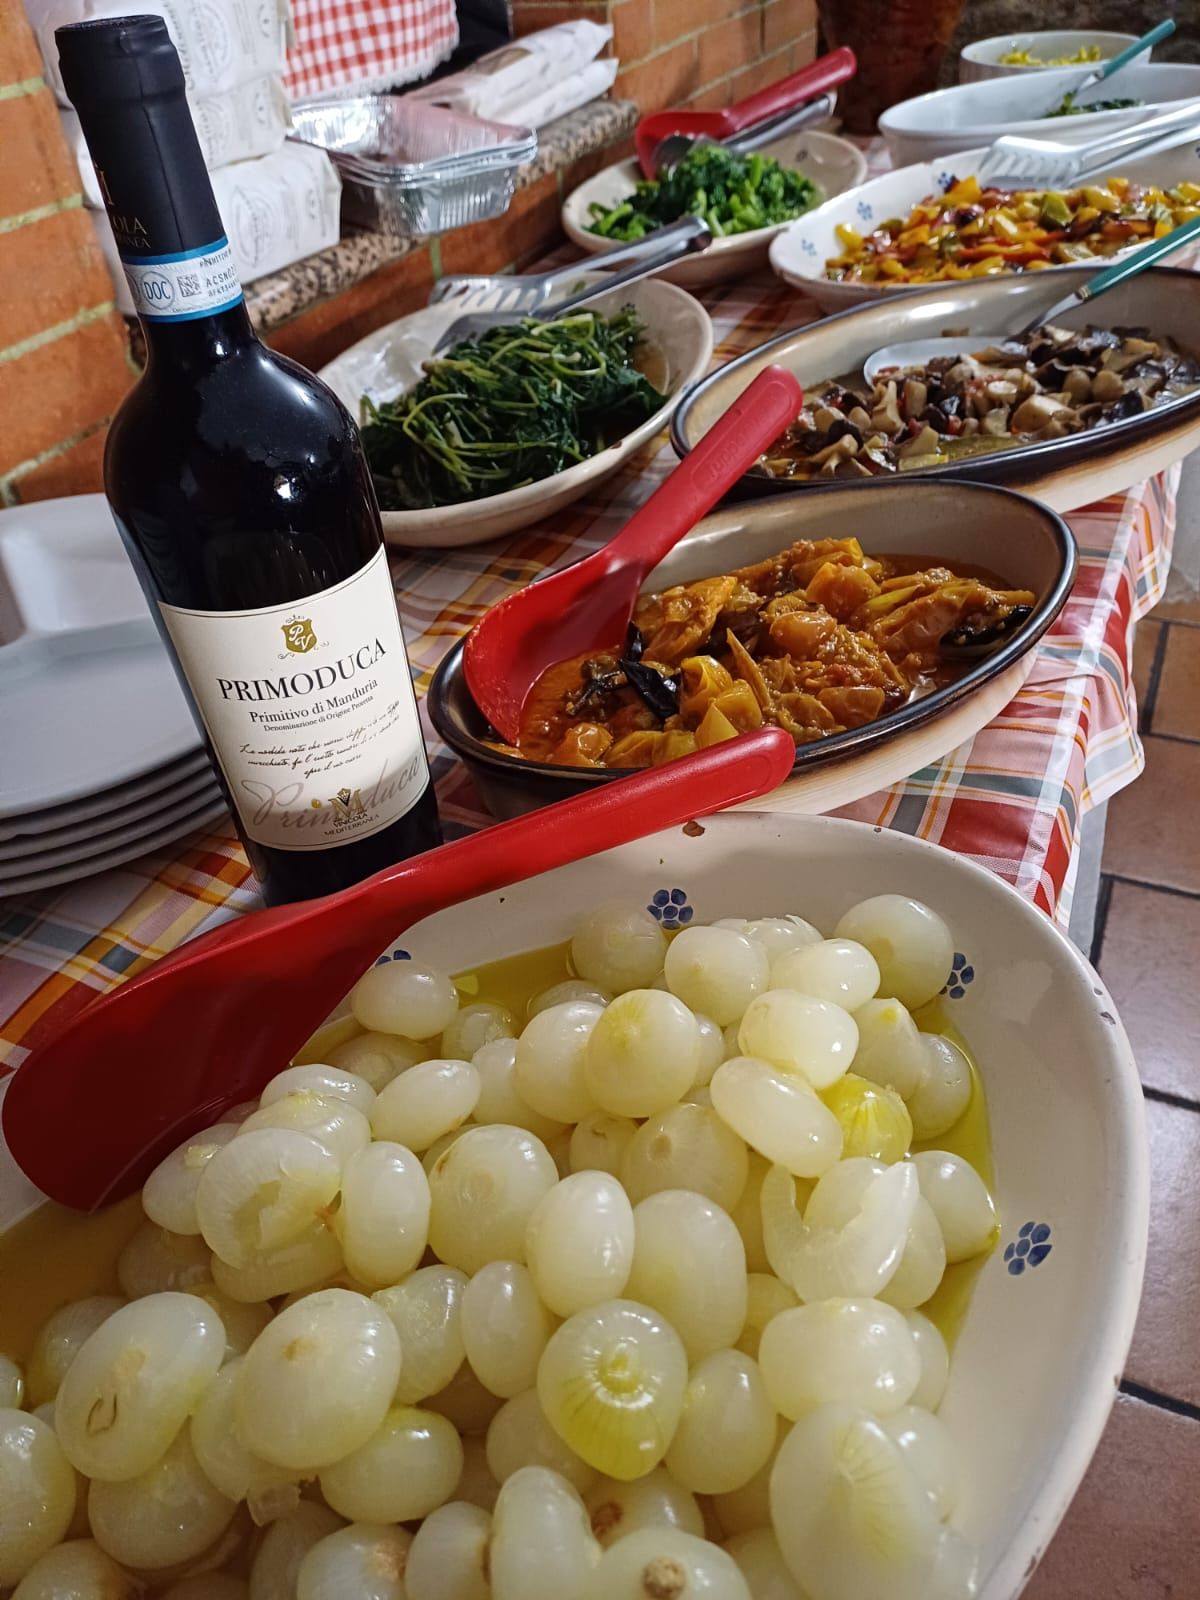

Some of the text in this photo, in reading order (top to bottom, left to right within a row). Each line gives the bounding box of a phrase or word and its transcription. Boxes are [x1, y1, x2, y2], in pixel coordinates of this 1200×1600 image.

[143, 280, 171, 300] DOC
[215, 637, 387, 702] PRIMODUCA
[249, 708, 309, 723] Primitivo
[312, 702, 325, 715] di
[326, 678, 378, 710] Manduria
[263, 719, 318, 732] Denominazione
[318, 715, 326, 723] di
[326, 707, 351, 719] Origine
[333, 812, 368, 828] VINICOLA
